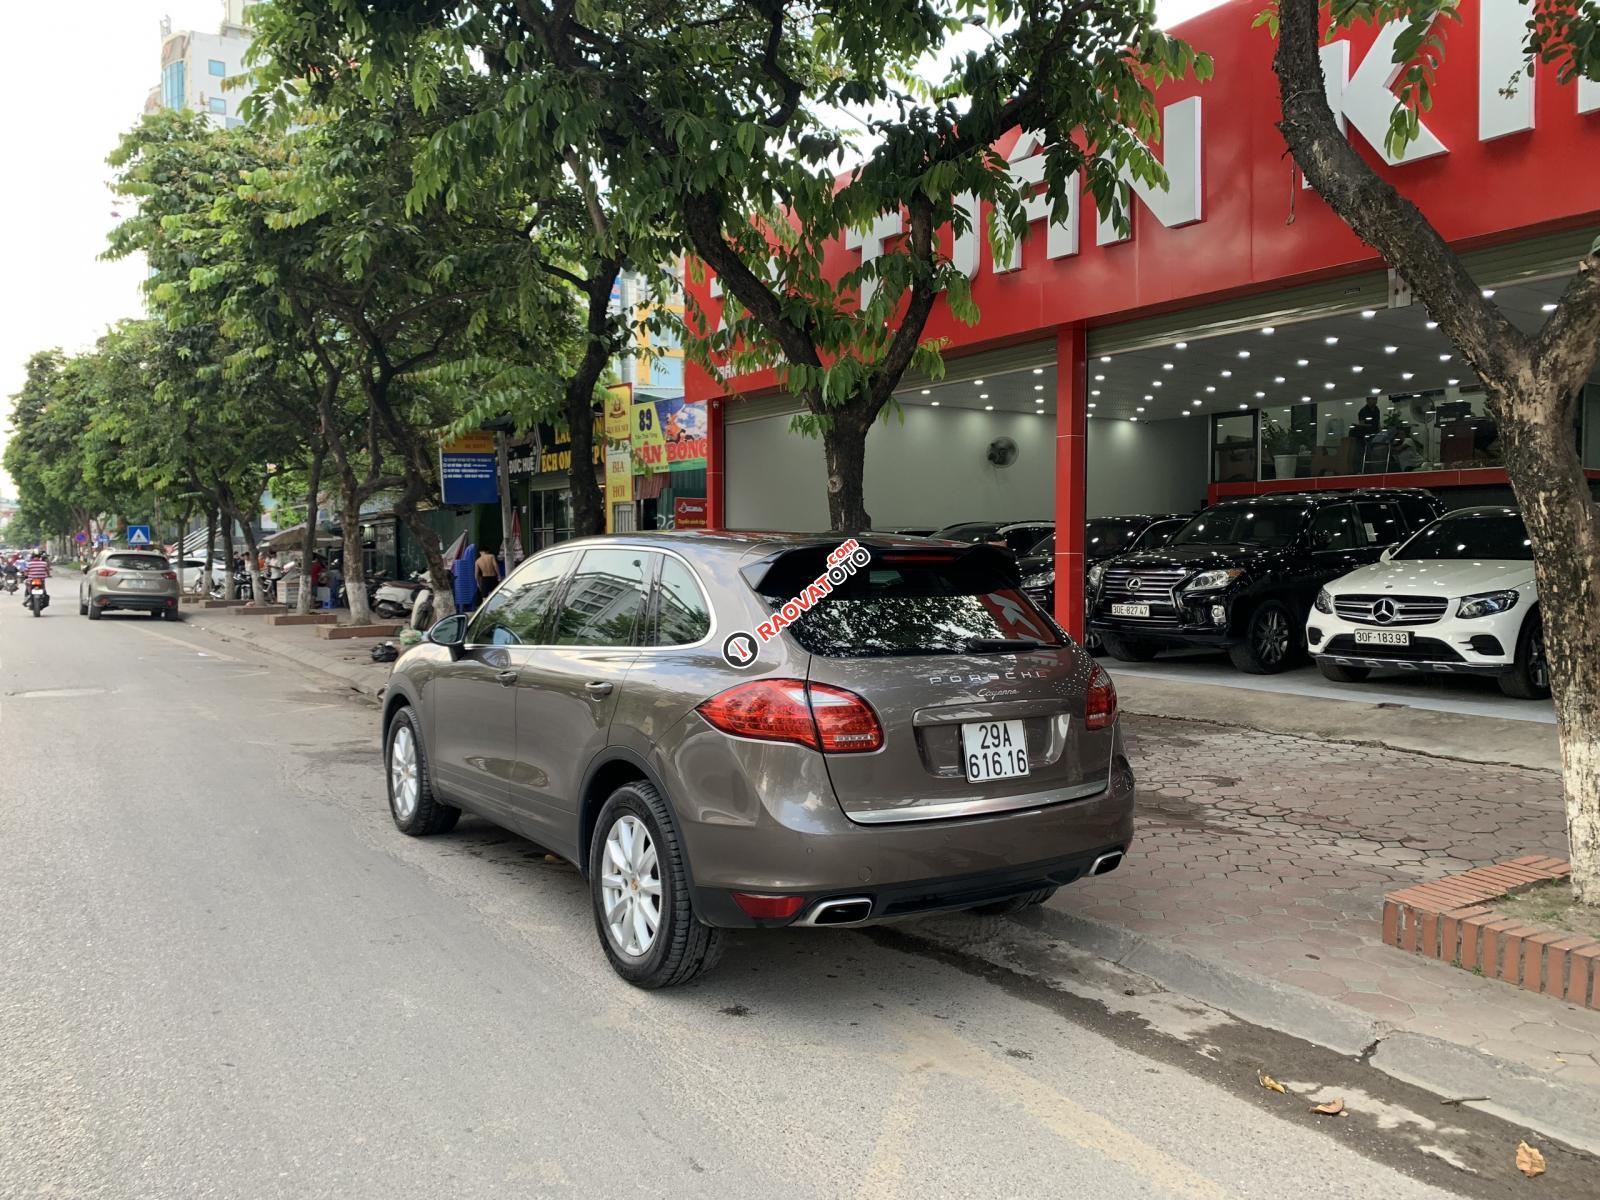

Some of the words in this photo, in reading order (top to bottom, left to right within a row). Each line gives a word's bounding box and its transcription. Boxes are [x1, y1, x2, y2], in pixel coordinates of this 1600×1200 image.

[638, 408, 652, 432] 89
[1356, 631, 1408, 644] 30F-183.93
[976, 687, 1018, 701] Cayenne
[979, 722, 1012, 750] 29A
[968, 749, 1027, 779] 616.16
